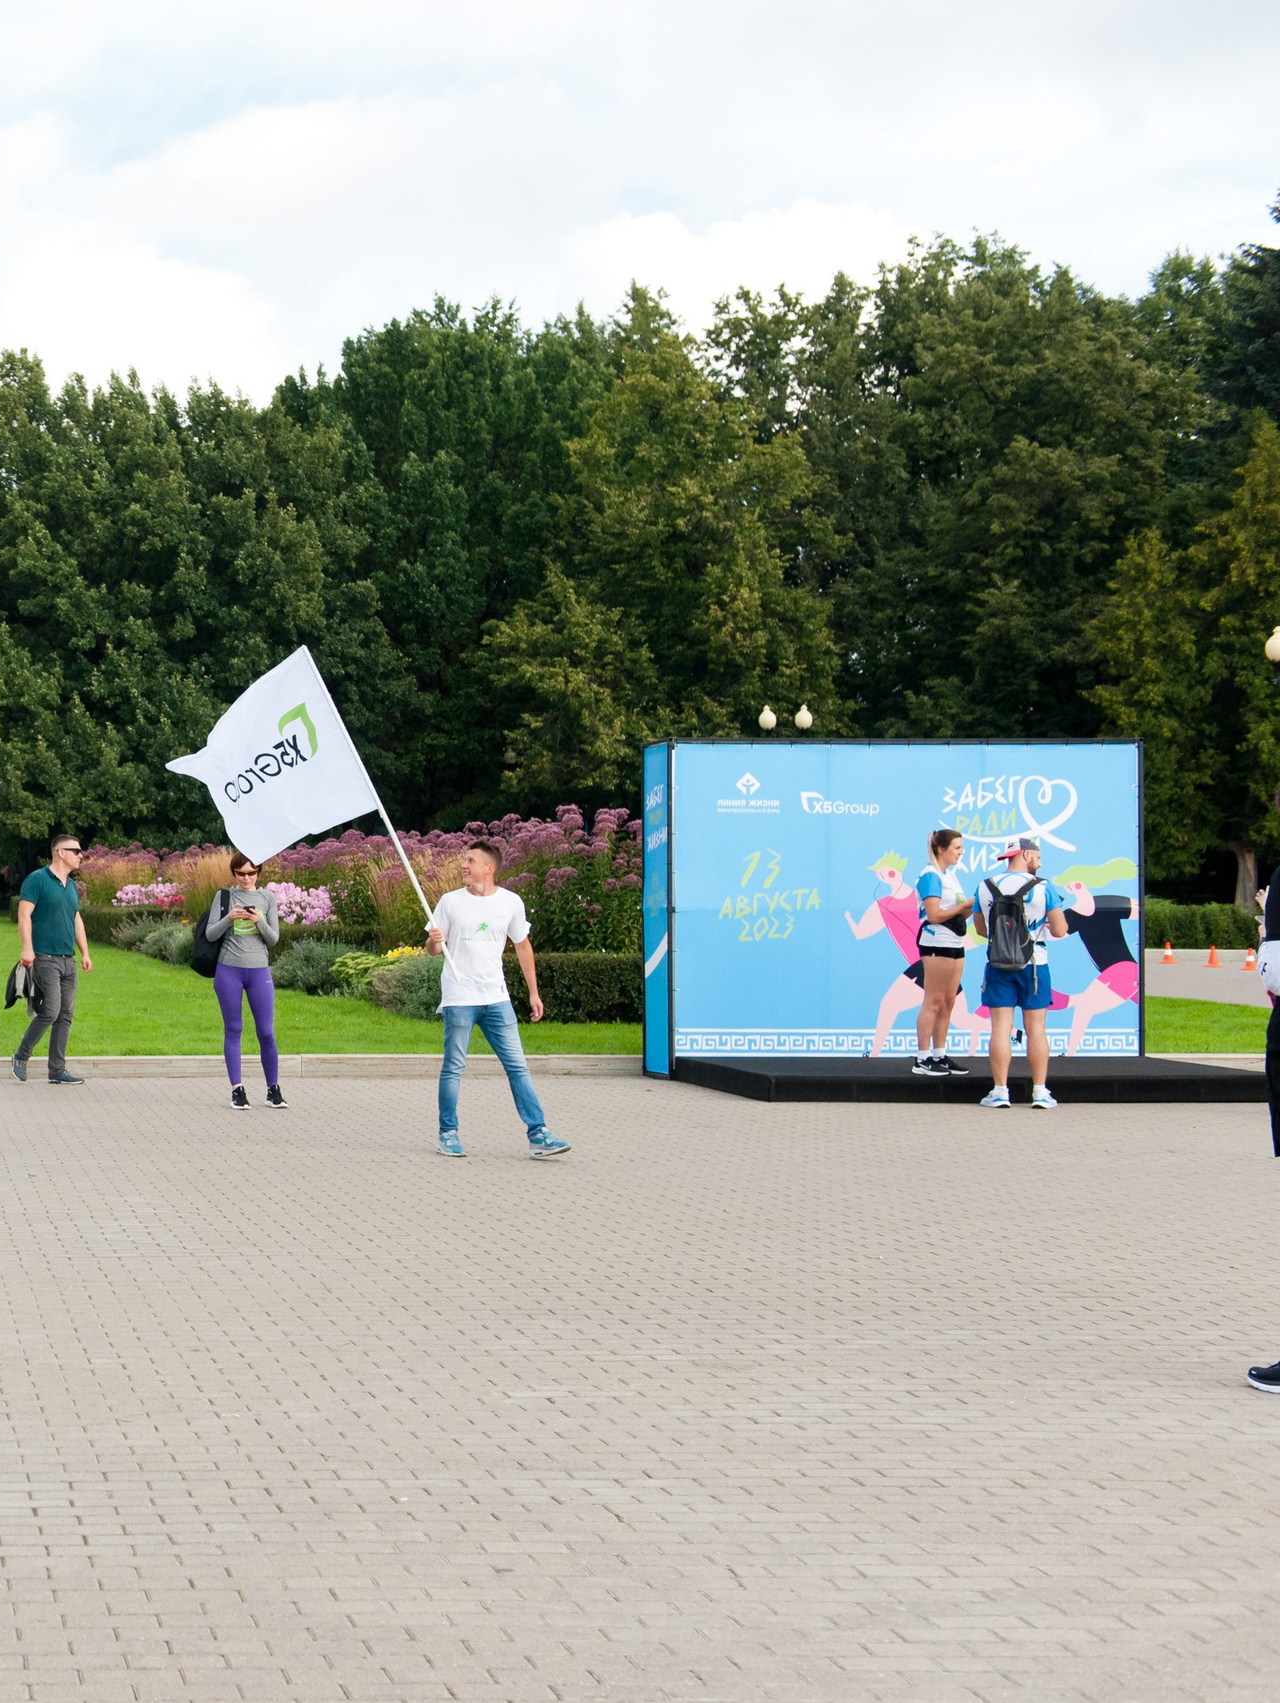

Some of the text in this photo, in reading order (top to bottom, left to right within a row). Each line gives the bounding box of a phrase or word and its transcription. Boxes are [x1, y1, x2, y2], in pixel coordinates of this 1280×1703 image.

[717, 799, 780, 807] ЛИНИЯ ЖИЗНИ
[942, 774, 1022, 814] ЗАБЕГ
[812, 801, 880, 817] X5Group
[956, 808, 1016, 836] РАДИ
[741, 846, 782, 889] 13
[718, 888, 820, 920] АВГУСТА
[739, 913, 795, 941] 2023
